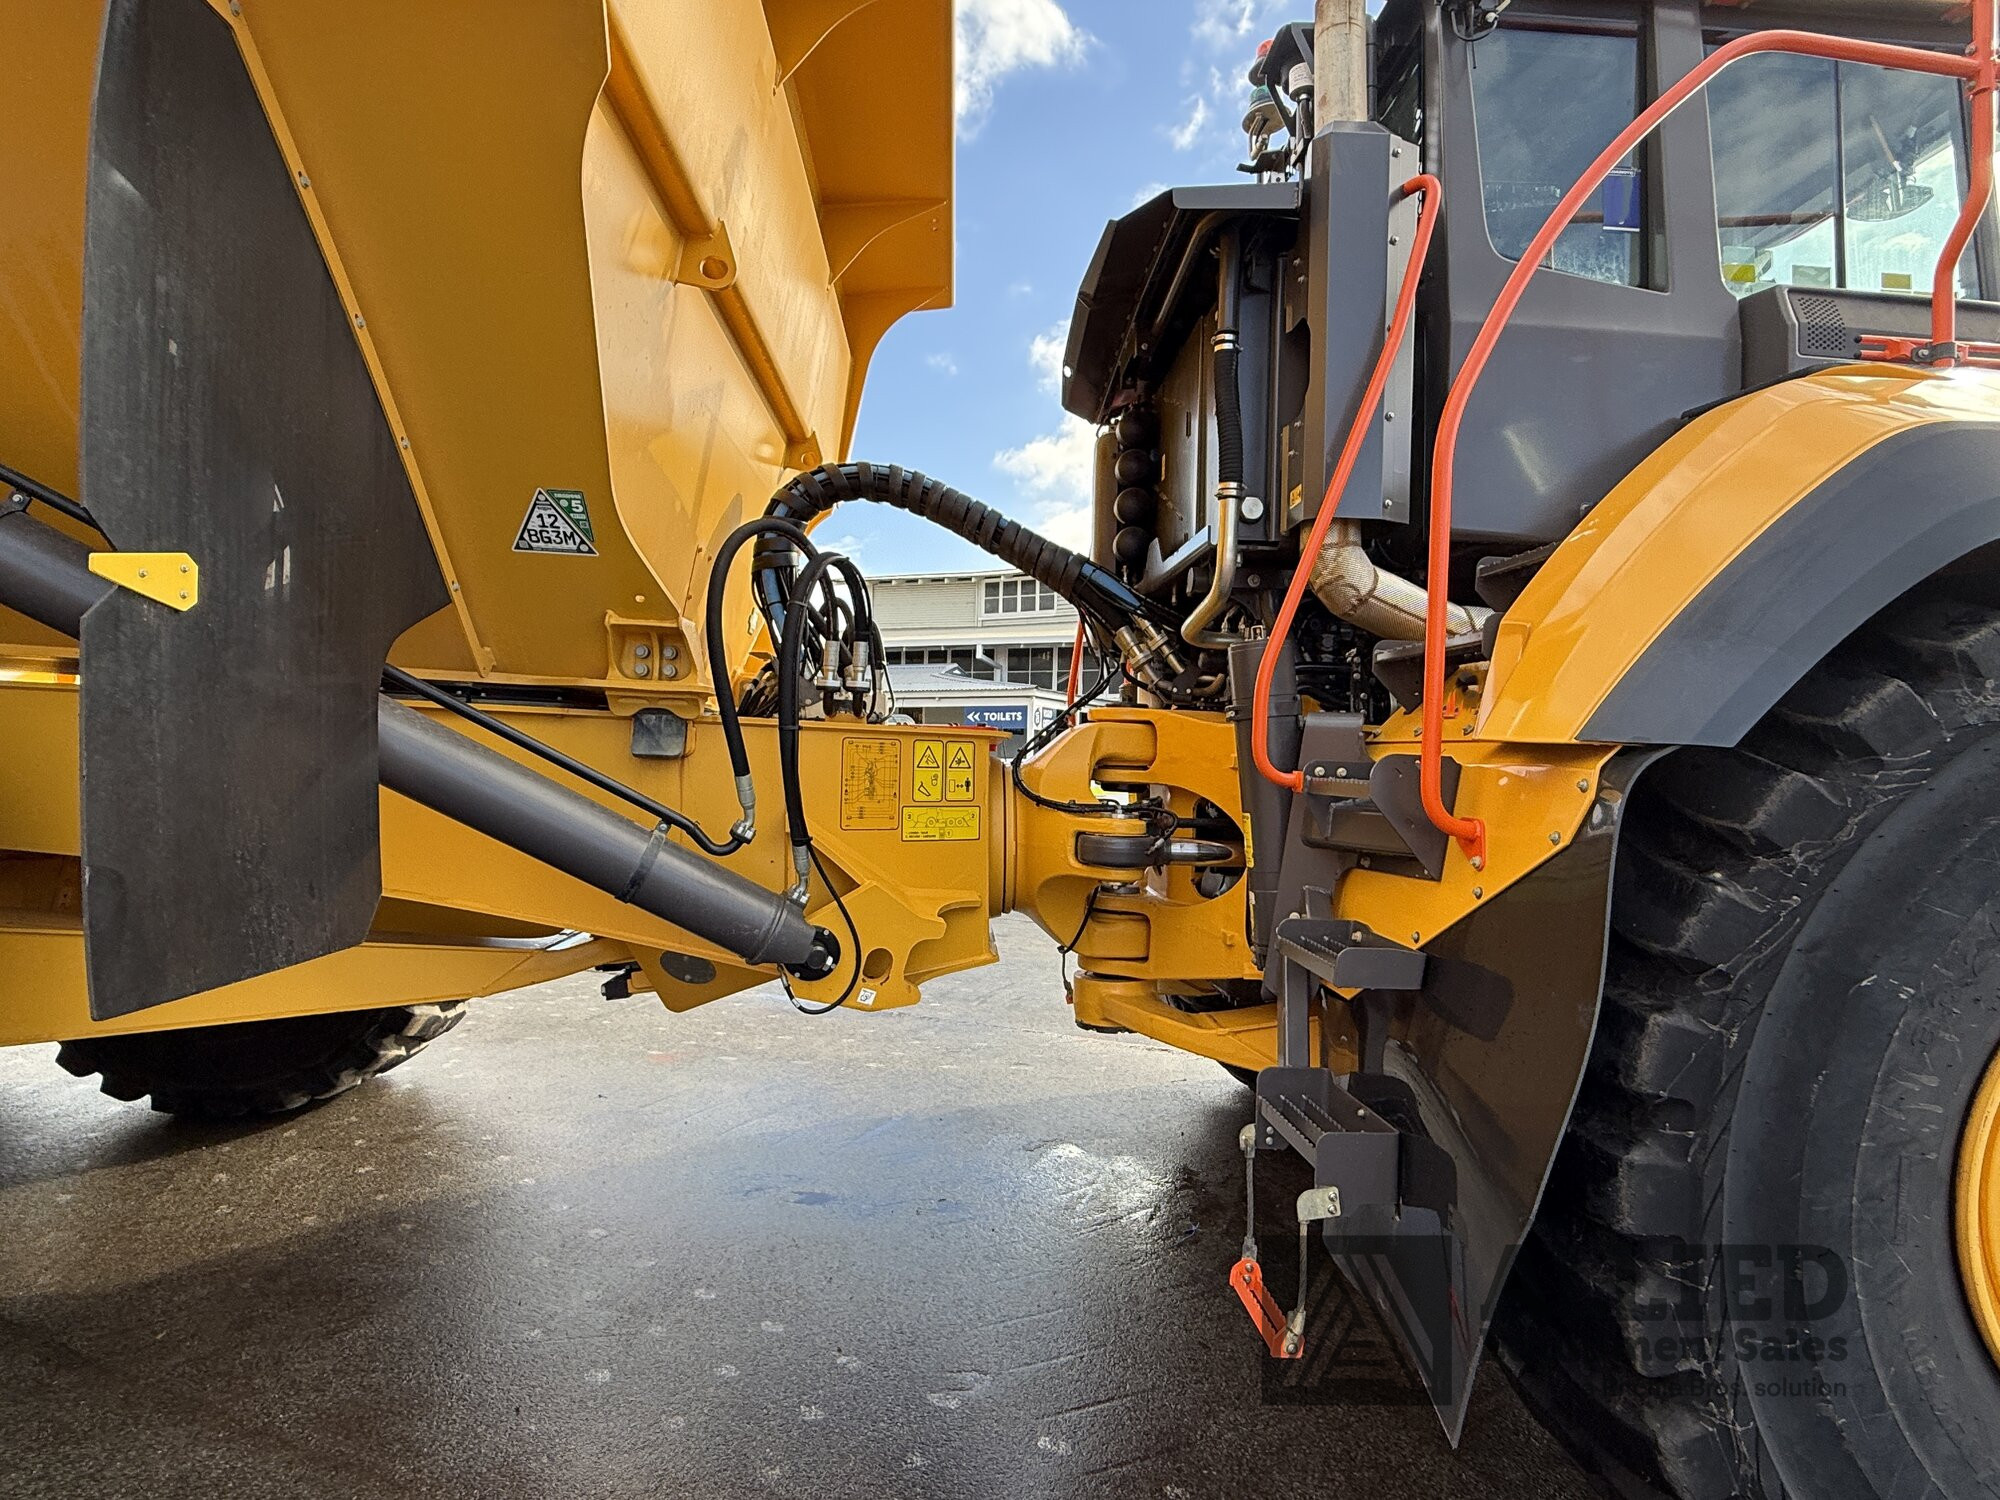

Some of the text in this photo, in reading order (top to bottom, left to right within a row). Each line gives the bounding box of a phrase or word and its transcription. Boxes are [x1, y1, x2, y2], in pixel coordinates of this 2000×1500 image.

[571, 500, 584, 513] 5
[536, 513, 561, 529] 12
[527, 528, 577, 546] BG3M
[983, 711, 1023, 722] TOILETS
